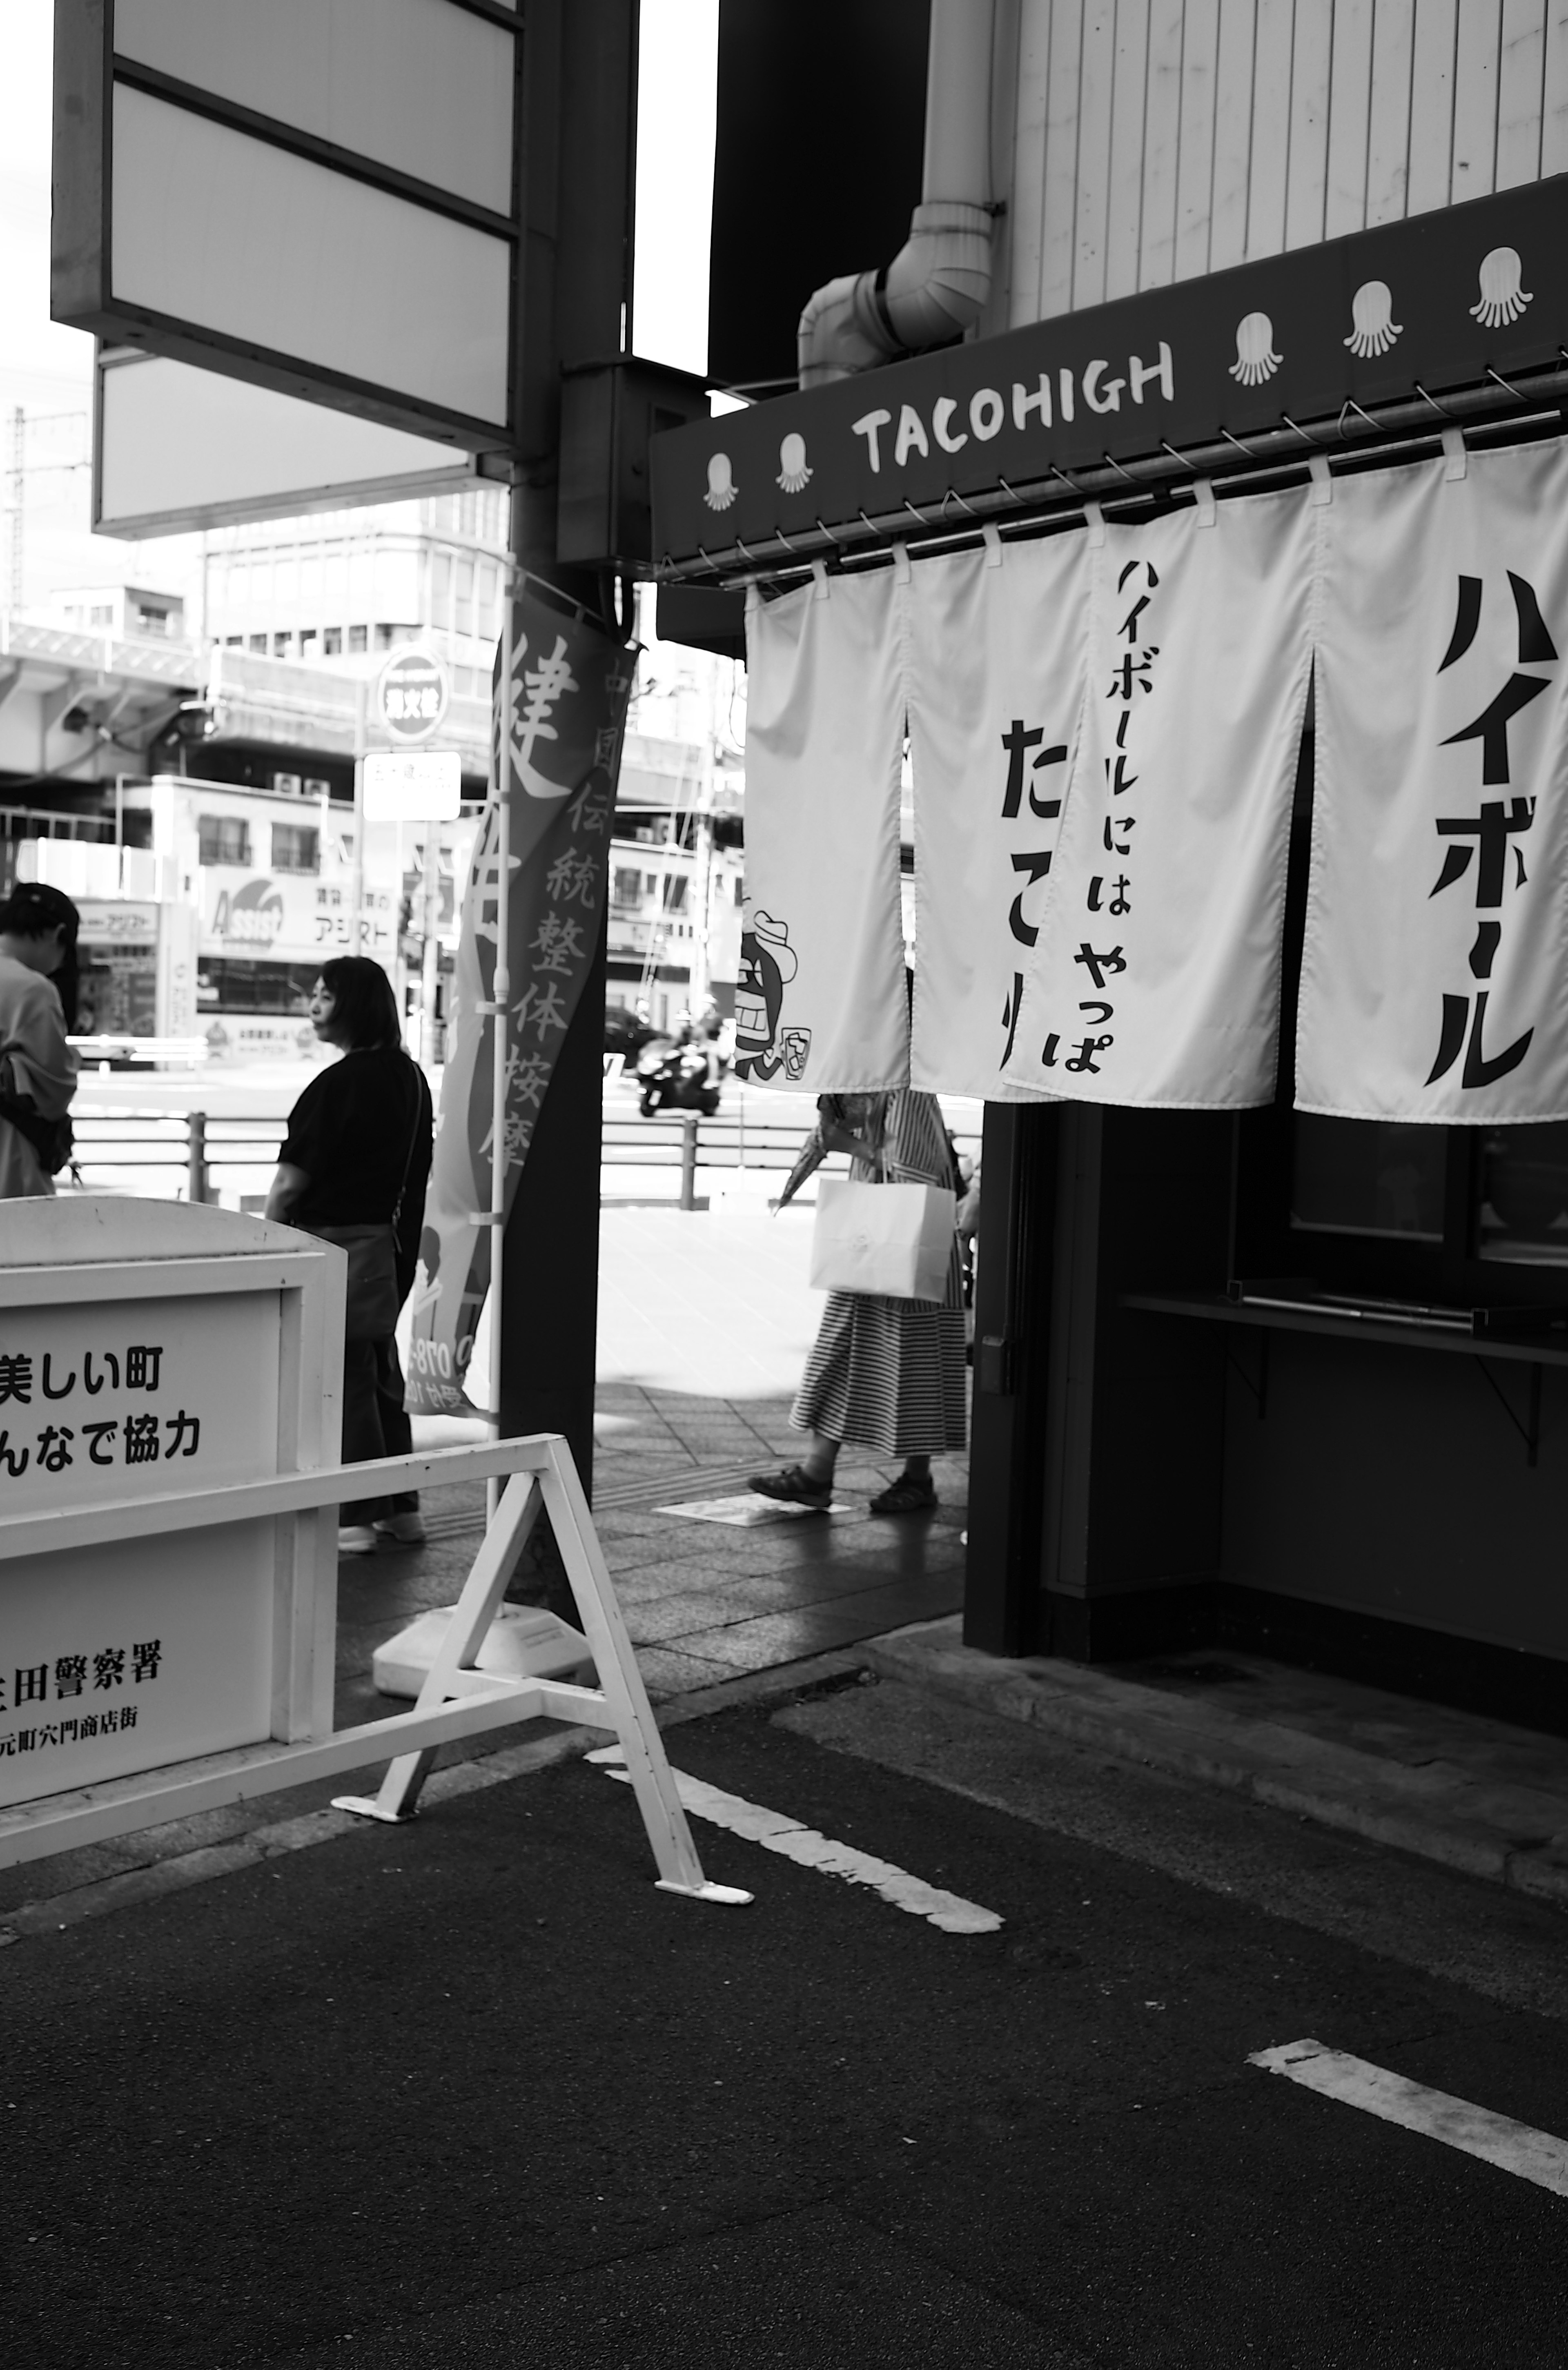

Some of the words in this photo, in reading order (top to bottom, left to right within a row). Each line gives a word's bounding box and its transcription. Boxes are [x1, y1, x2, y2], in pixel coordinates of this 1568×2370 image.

[851, 340, 1175, 474] TACOHIGH
[1041, 561, 1160, 1074] ハイボールにはやっぱ
[1423, 570, 1559, 1089] ハイボール
[212, 890, 283, 941] Assist
[0, 1346, 163, 1405] 美しい町
[0, 1410, 200, 1477] んなで協力
[0, 1639, 162, 1711] 田警察署
[0, 1706, 138, 1757] 元町穴門商店街
